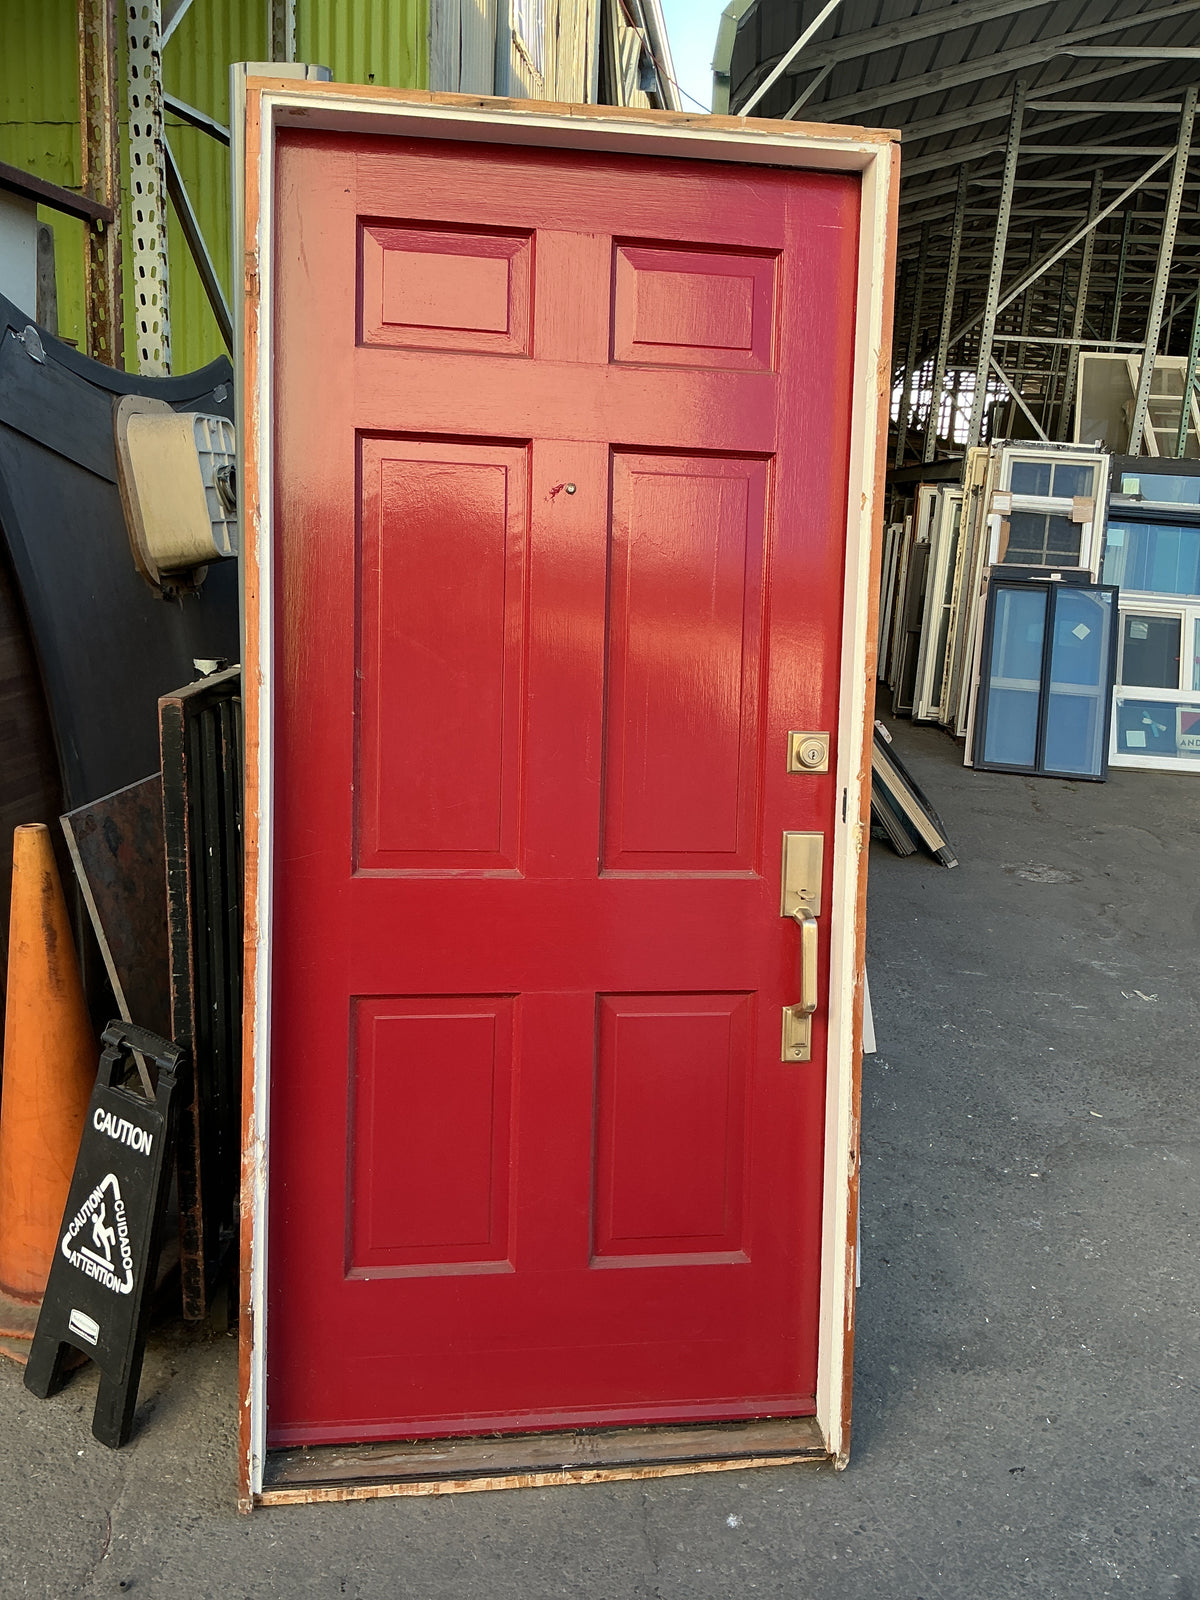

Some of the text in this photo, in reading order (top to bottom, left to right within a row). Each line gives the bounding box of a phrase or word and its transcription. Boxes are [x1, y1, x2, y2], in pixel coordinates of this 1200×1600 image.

[93, 1107, 153, 1156] CAUTION
[68, 1185, 104, 1237] CAUTION
[114, 1200, 133, 1270] CUIDADO
[69, 1250, 122, 1293] ATTENTION
